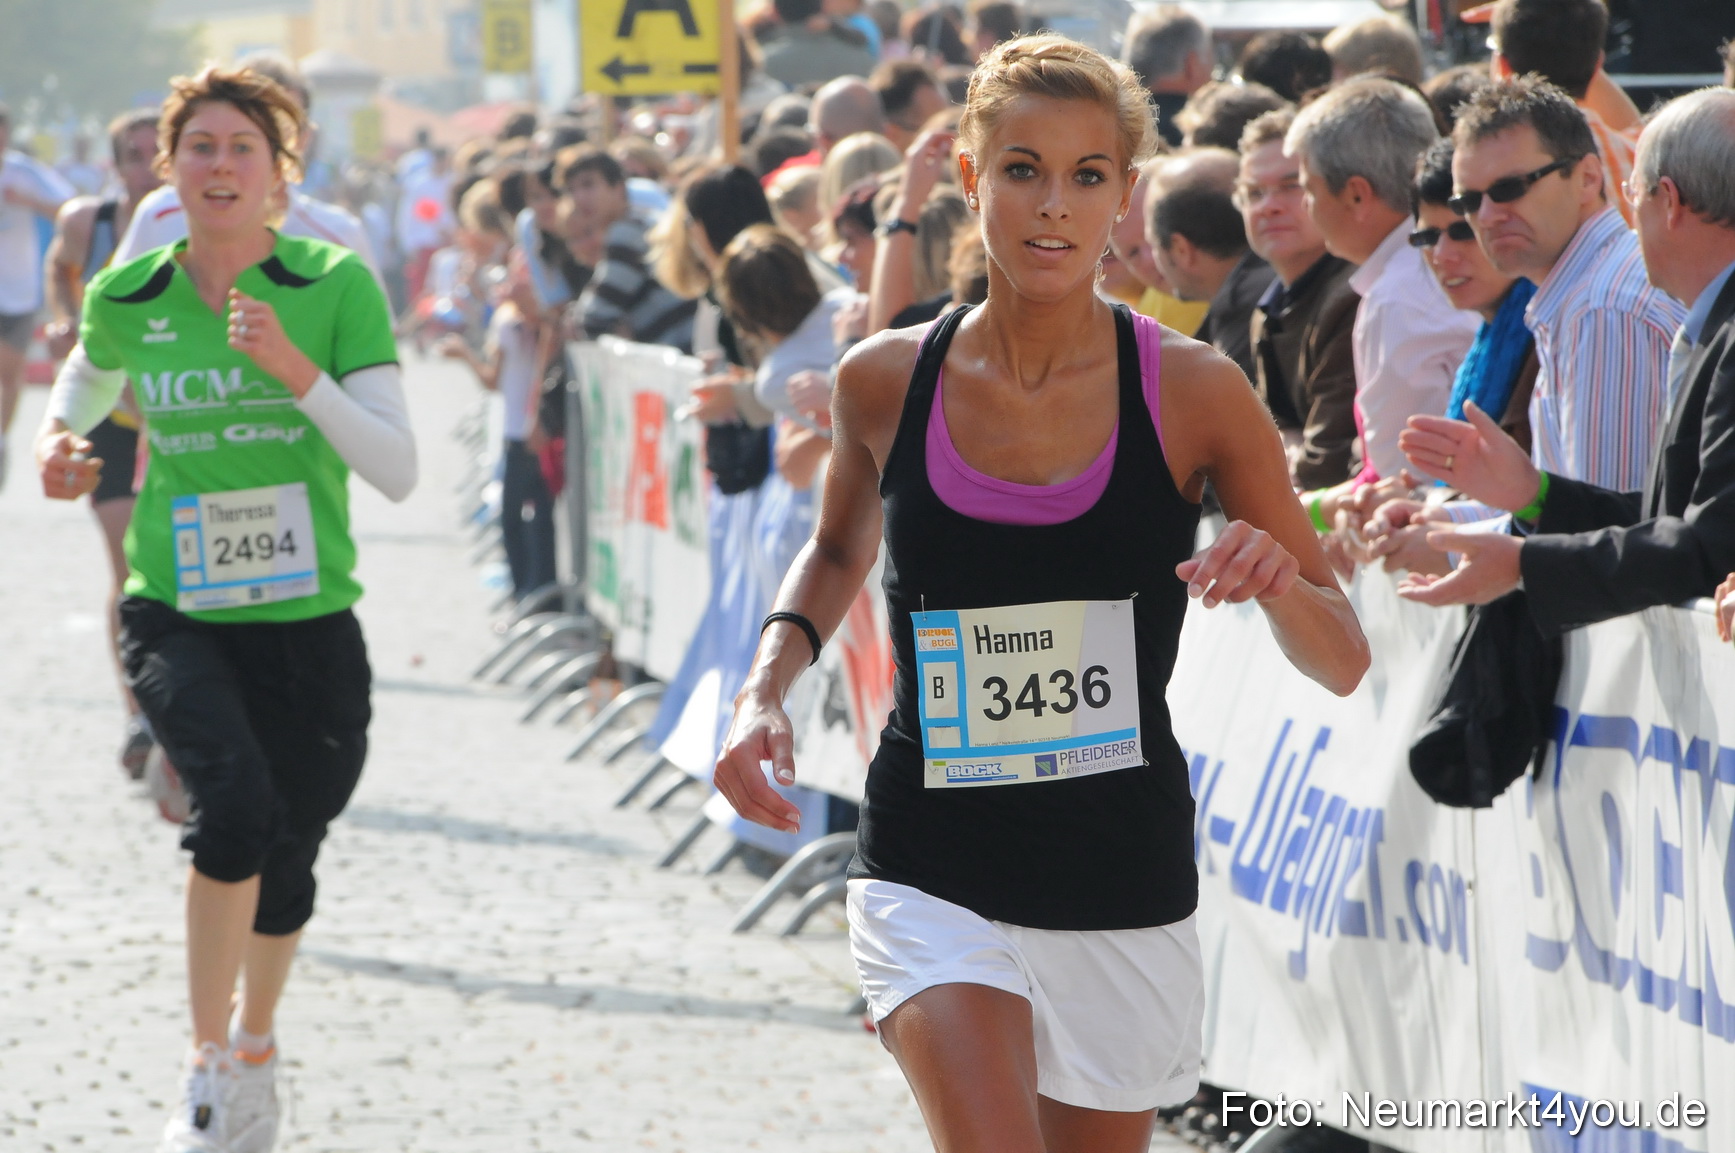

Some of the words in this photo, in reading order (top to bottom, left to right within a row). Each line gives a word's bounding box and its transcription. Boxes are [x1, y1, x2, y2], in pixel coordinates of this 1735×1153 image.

[142, 367, 242, 406] MCM
[207, 503, 276, 523] Theresa
[213, 528, 297, 567] 2494
[973, 624, 1054, 655] Hanna
[933, 676, 945, 699] B
[982, 665, 1112, 721] 3436
[1060, 740, 1137, 766] PFLEIDERER
[1061, 755, 1139, 775] AKTIENGESELLSCHAFT
[946, 763, 1002, 778] BOCK
